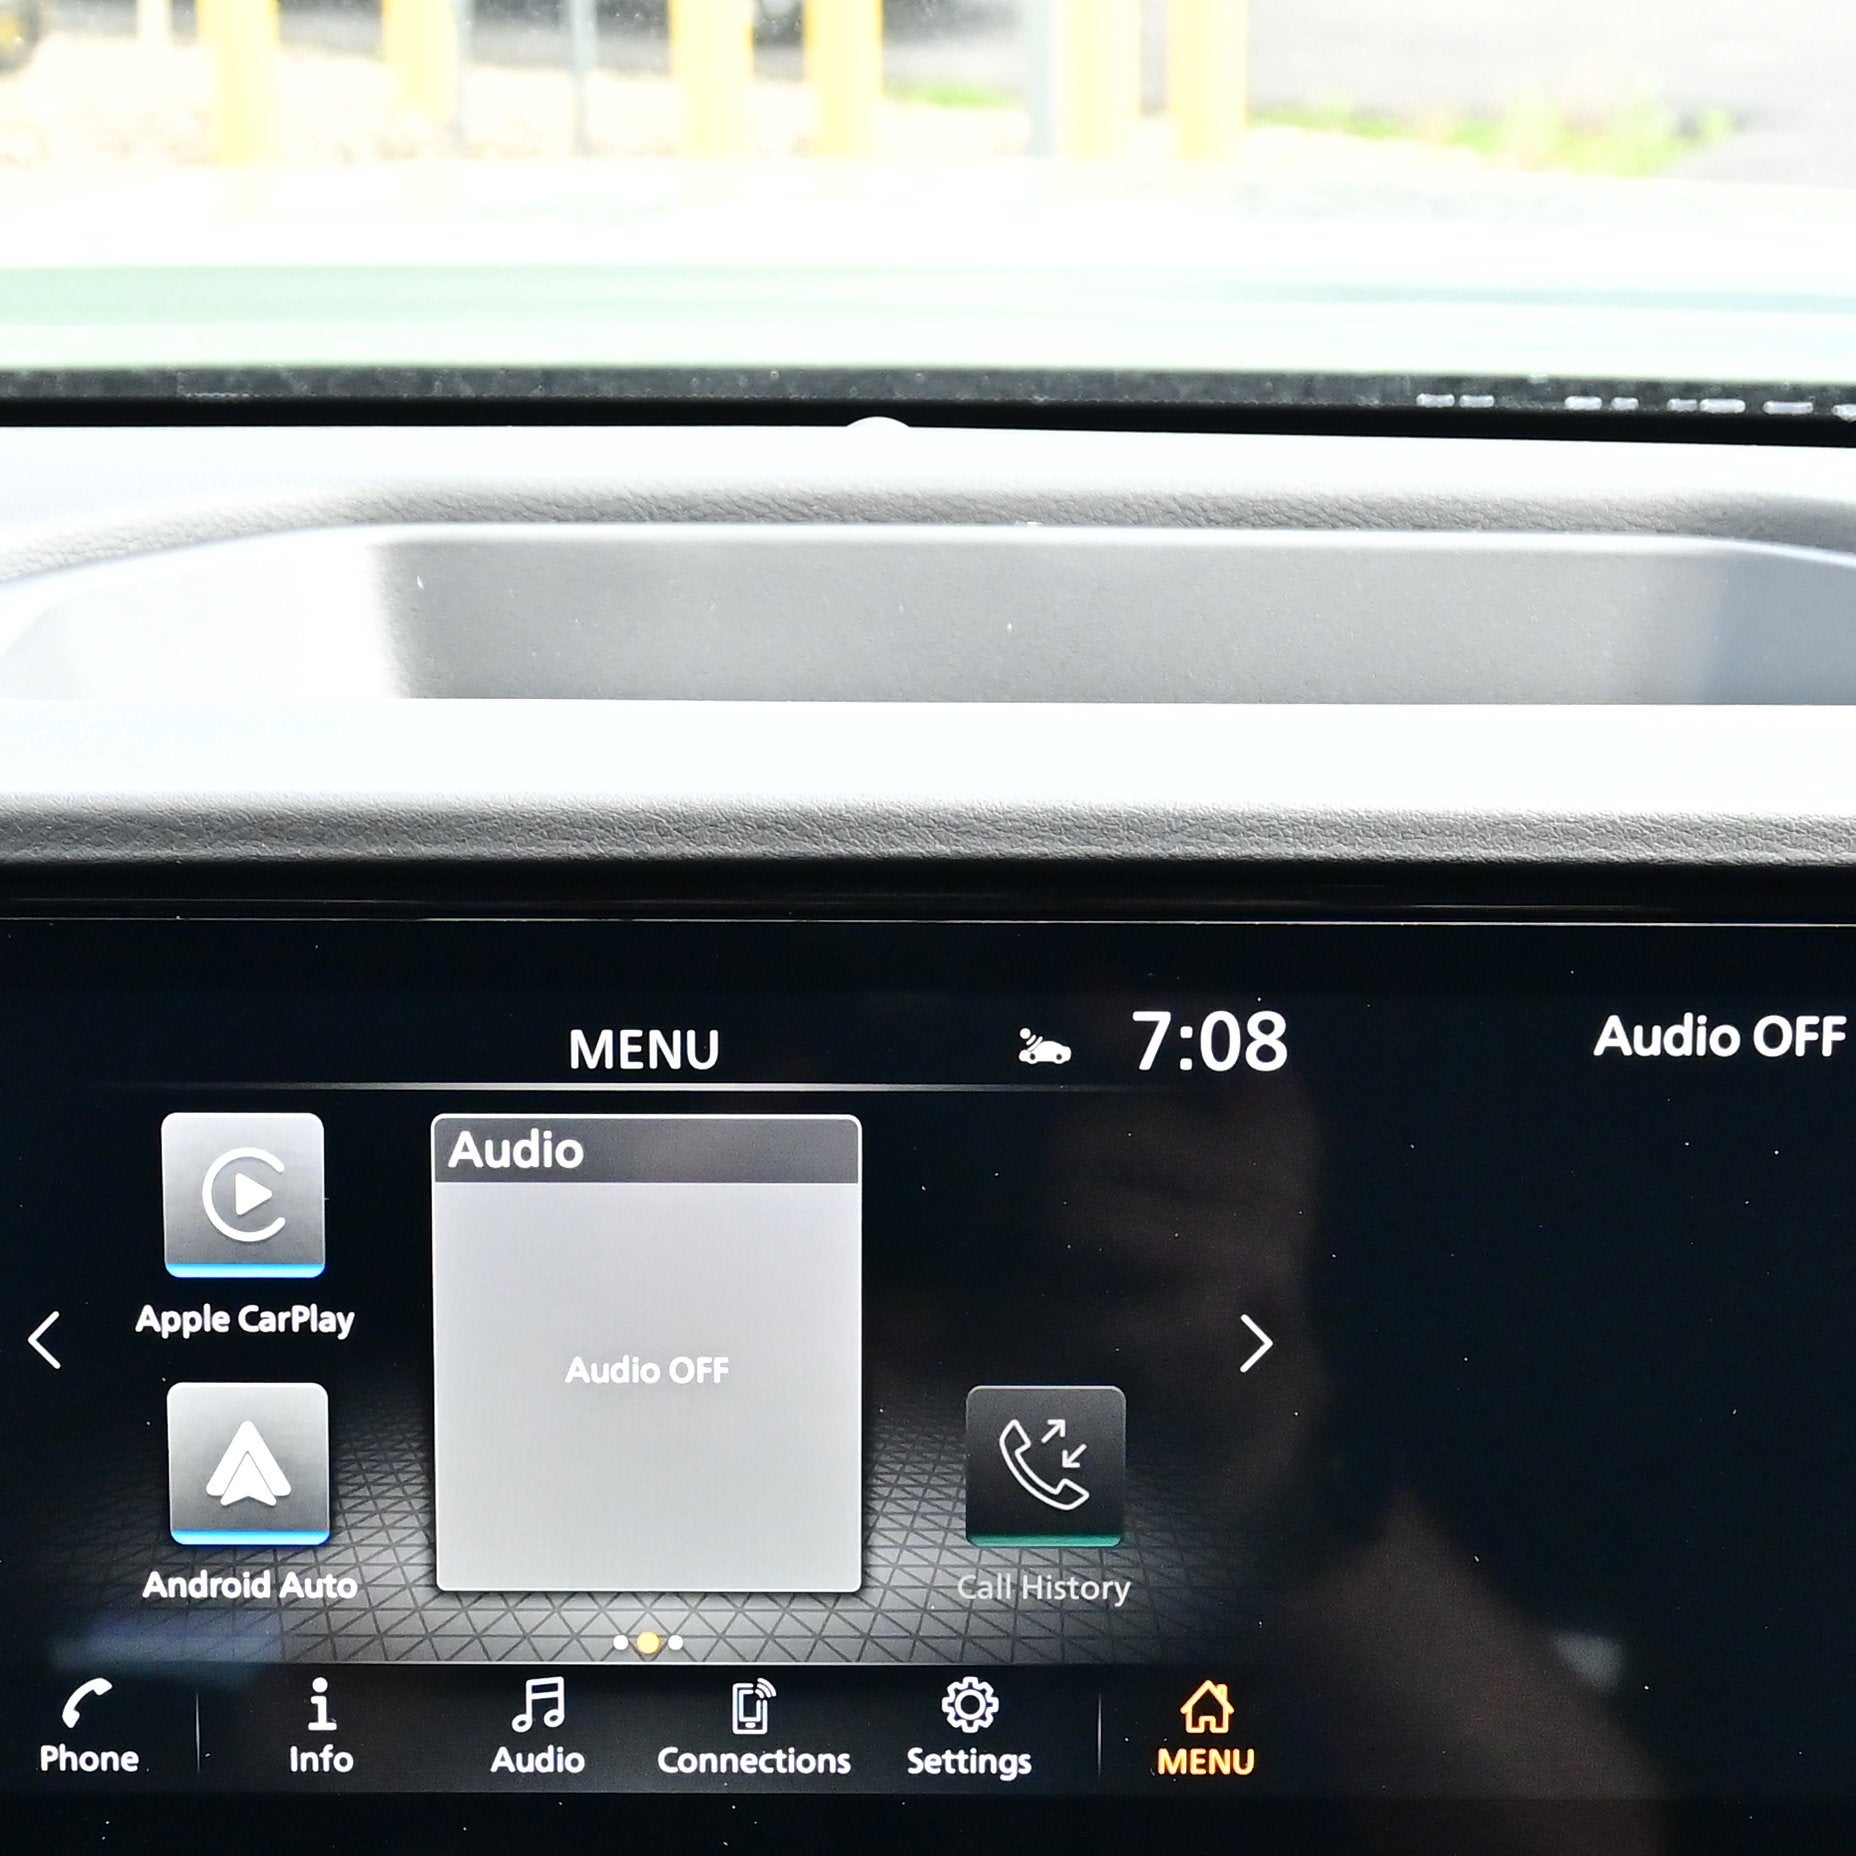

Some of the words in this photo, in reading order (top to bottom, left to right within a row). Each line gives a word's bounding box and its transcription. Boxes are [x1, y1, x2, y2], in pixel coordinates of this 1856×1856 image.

[570, 1029, 719, 1070] MENU
[1132, 1010, 1288, 1072] 7:08
[1593, 1012, 1741, 1057] Audio
[1753, 1014, 1847, 1058] OFF
[447, 1127, 584, 1169] Audio
[135, 1303, 231, 1340] Apple
[237, 1303, 355, 1340] CarPlay
[564, 1354, 661, 1384] Audio
[668, 1356, 730, 1384] OFF
[142, 1569, 271, 1599] Android
[278, 1571, 358, 1599] Auto
[957, 1572, 1011, 1600] Call
[1022, 1574, 1131, 1607] History
[40, 1743, 140, 1772] Phone
[290, 1743, 354, 1773] Info
[490, 1744, 586, 1774] Audio
[657, 1746, 852, 1775] Connections
[907, 1747, 1032, 1782] Settings
[1157, 1747, 1255, 1776] MENU
